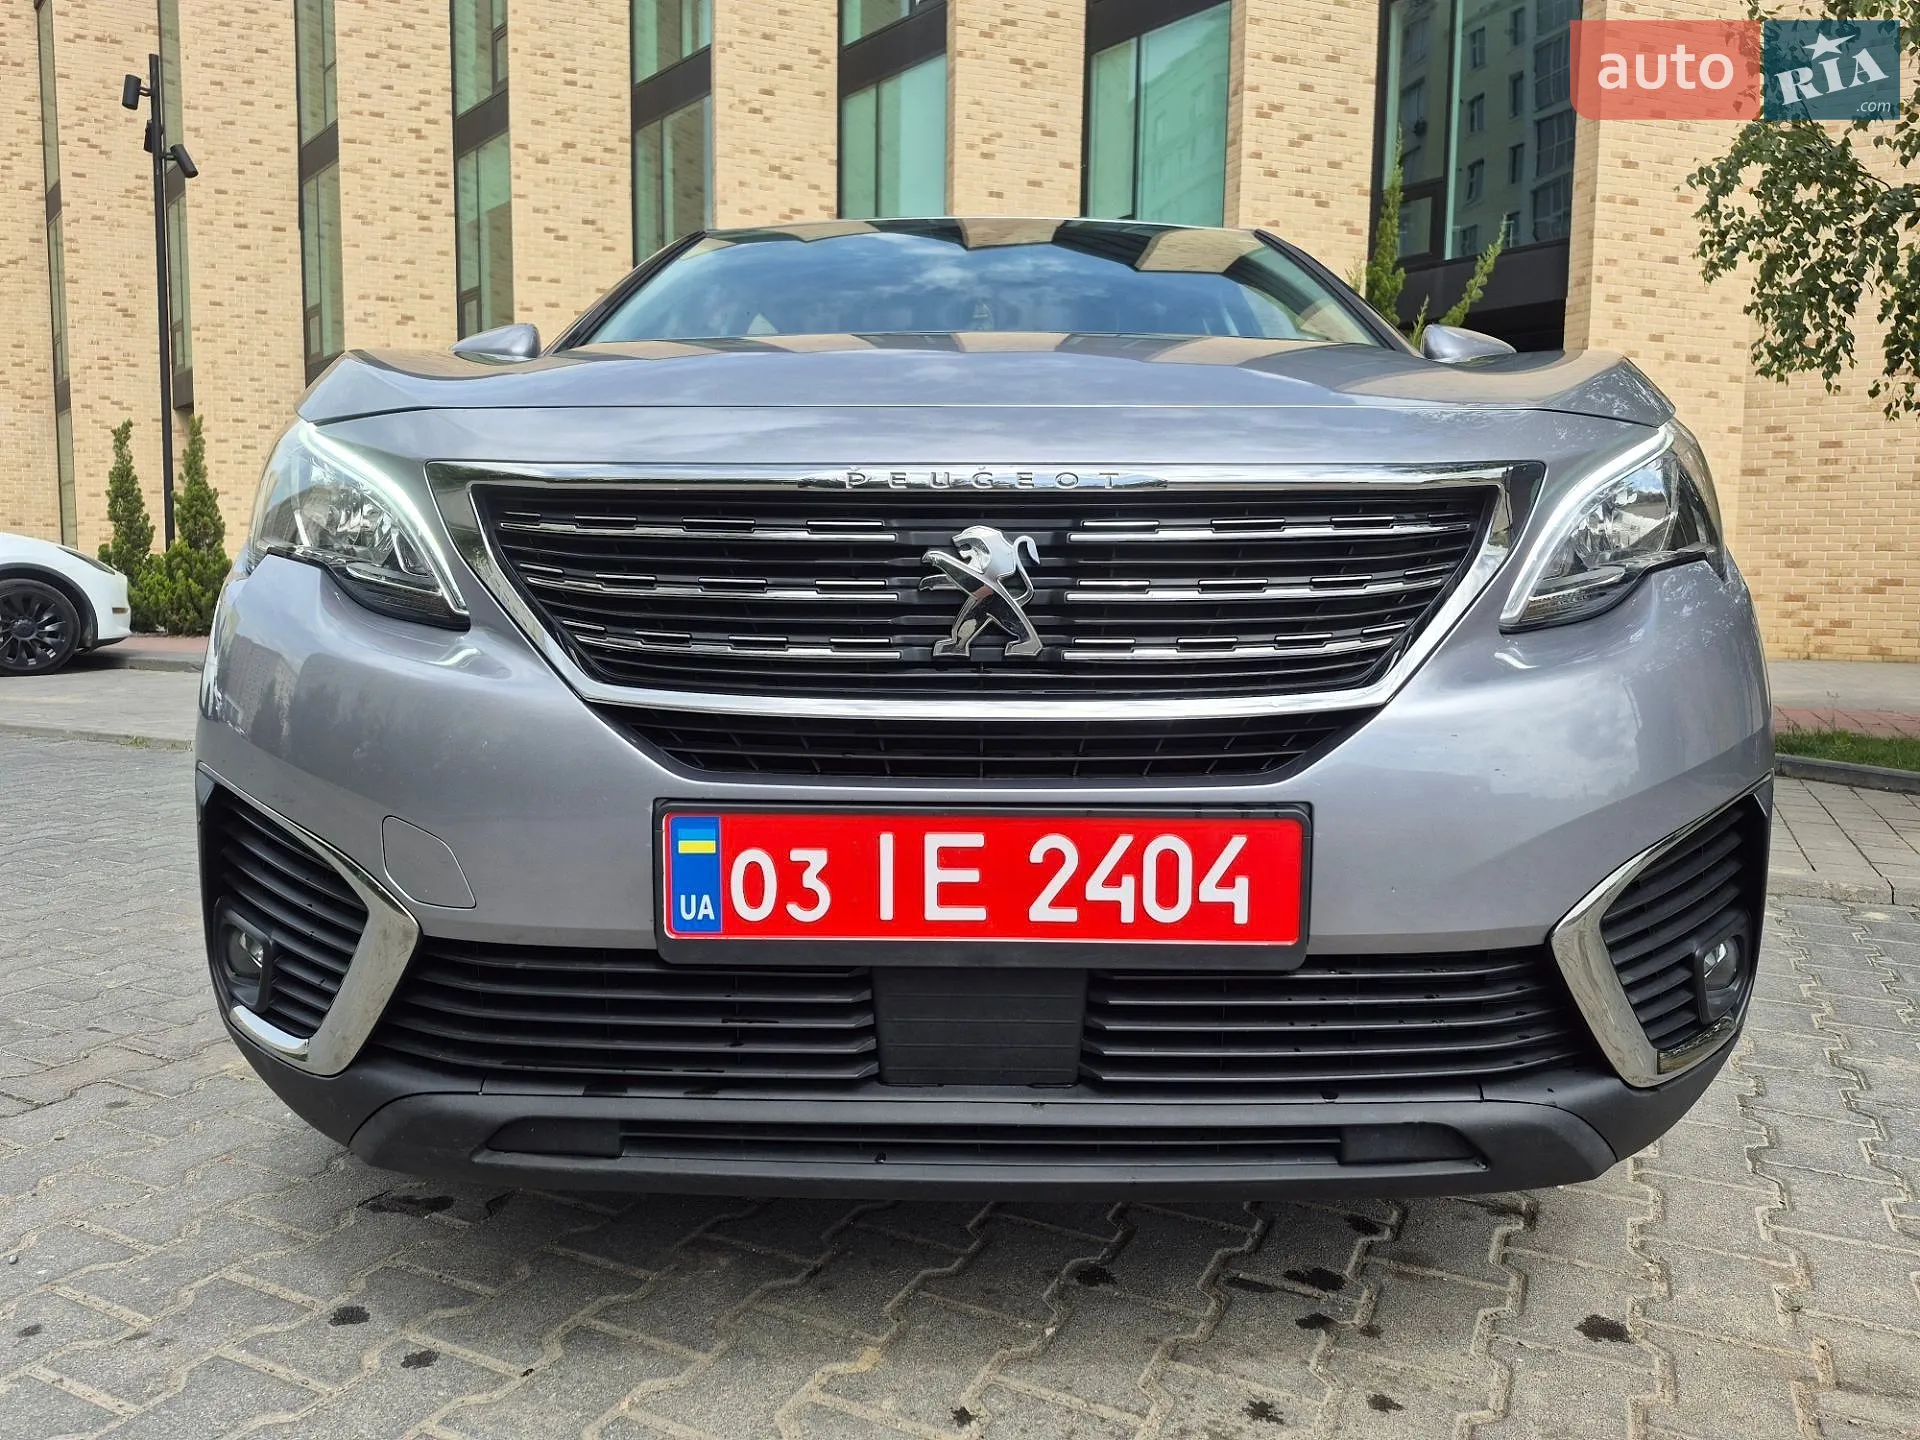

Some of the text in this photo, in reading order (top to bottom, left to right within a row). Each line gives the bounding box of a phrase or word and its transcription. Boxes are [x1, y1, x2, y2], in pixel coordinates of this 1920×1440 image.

[846, 472, 1119, 489] PEUGEOT
[730, 832, 1250, 925] 03 IE 2404
[680, 894, 716, 921] UA
